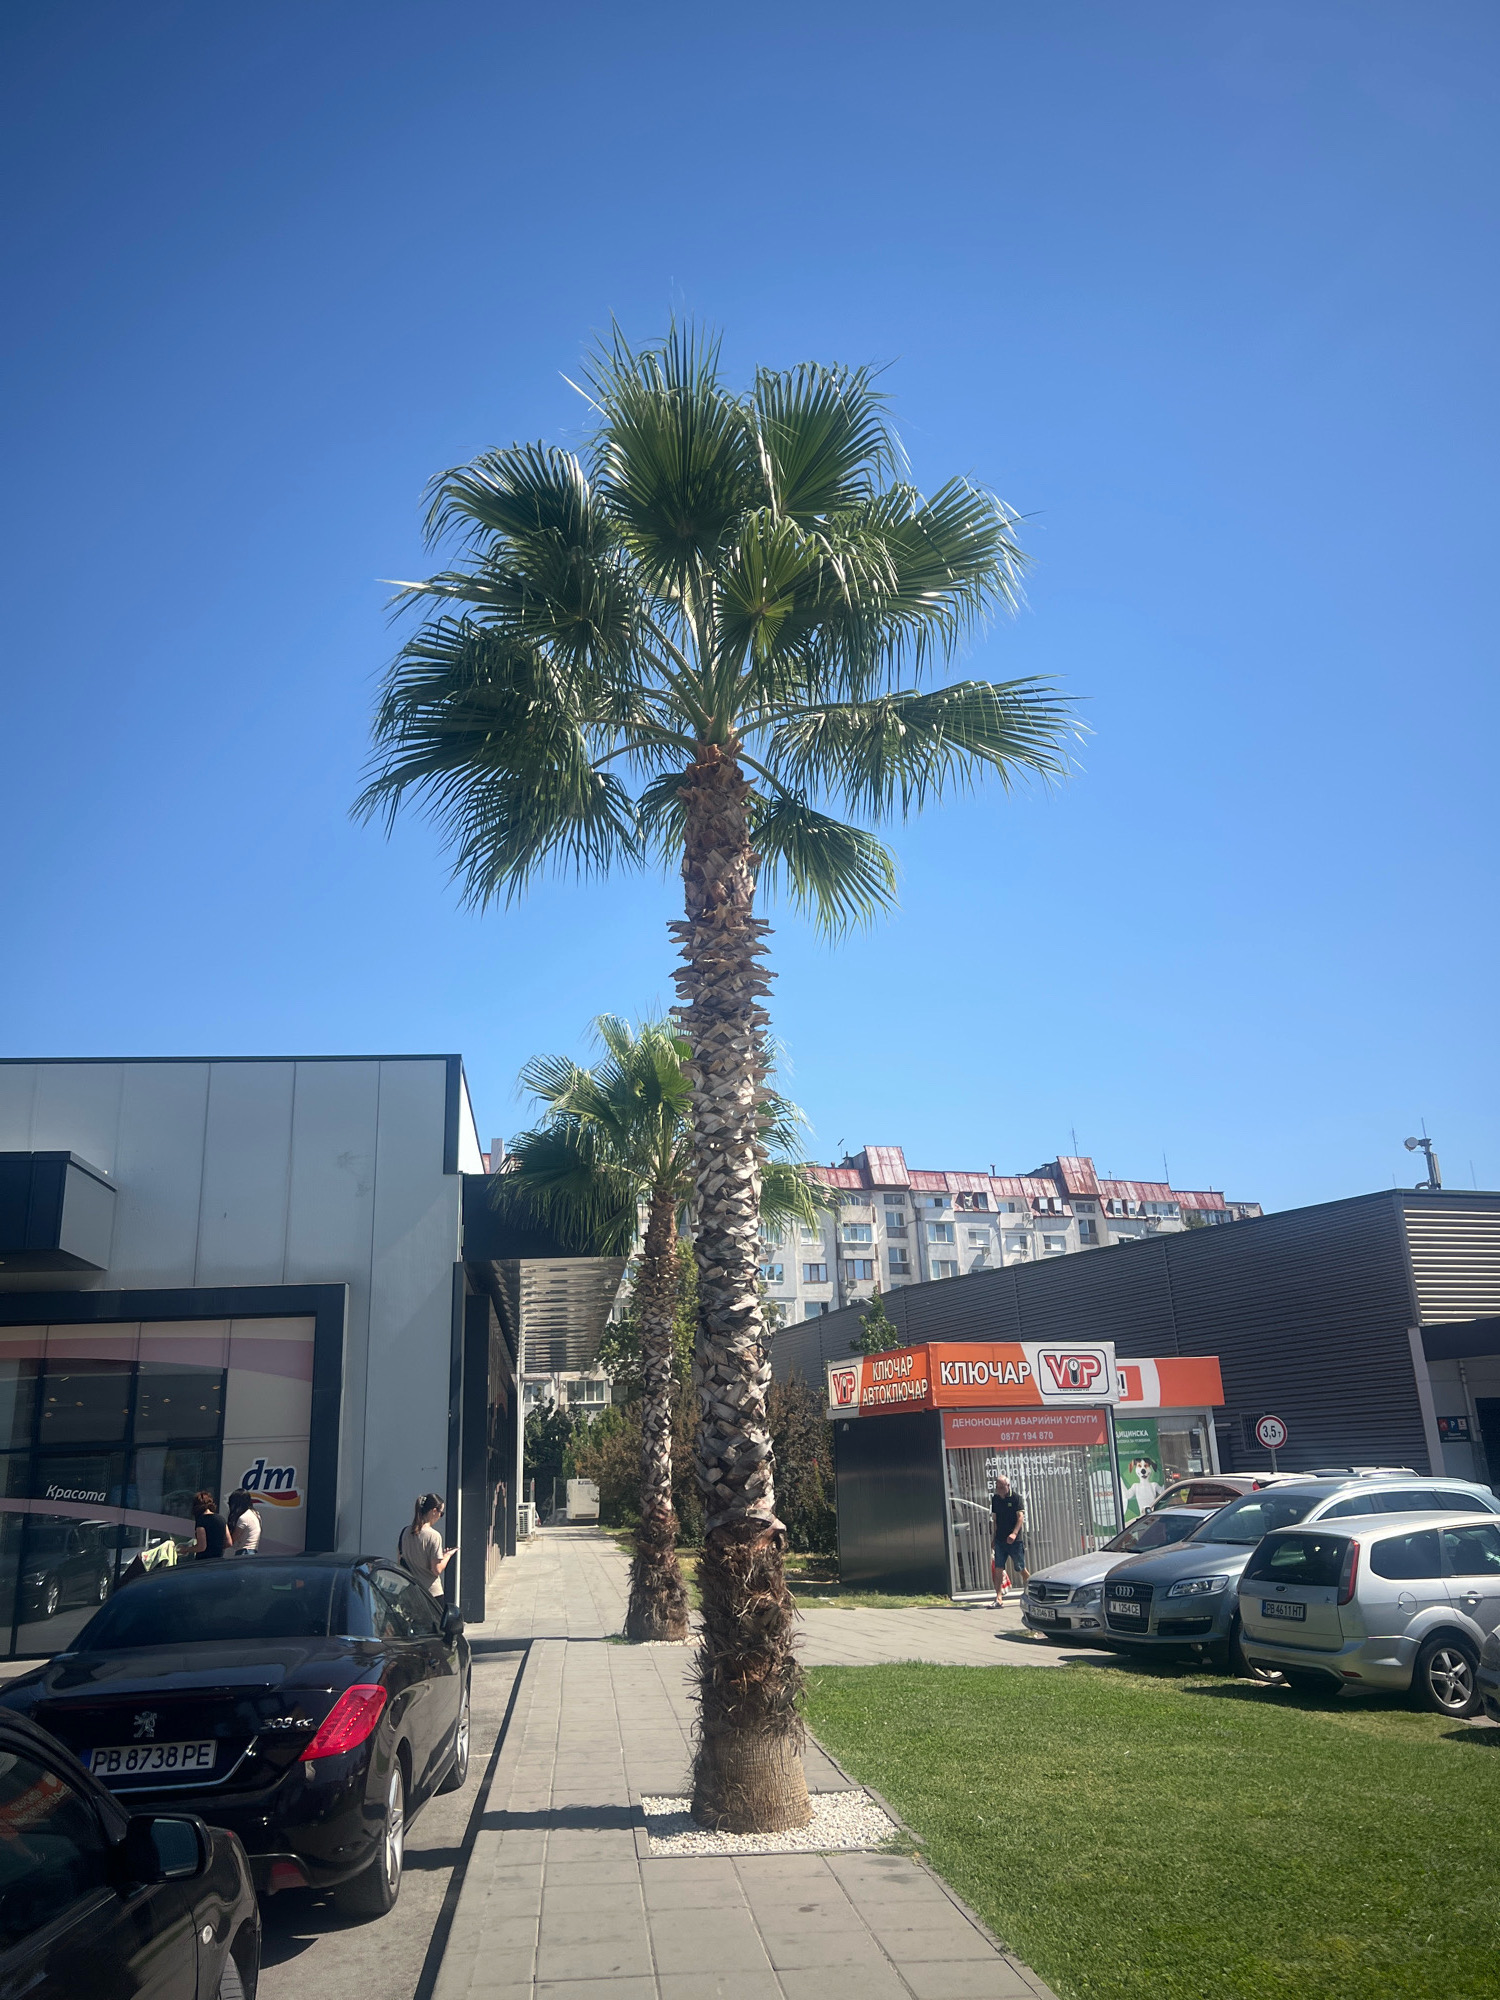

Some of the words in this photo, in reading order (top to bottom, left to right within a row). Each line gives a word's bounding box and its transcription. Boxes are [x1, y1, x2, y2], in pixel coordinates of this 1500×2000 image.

[872, 1355, 914, 1382] КЛЮЧАР
[940, 1361, 1032, 1385] КЛЮЧАР
[1043, 1355, 1102, 1388] VIP
[832, 1372, 856, 1404] VIP
[862, 1378, 928, 1406] АВТОКЛЮЧАР
[952, 1417, 1012, 1428] ДЕНОНОЩНИ
[1014, 1415, 1063, 1426] АВАРИЙНИ
[1064, 1415, 1098, 1425] УСЛУГИ
[1262, 1425, 1277, 1439] 3,5
[1000, 1432, 1019, 1441] 0877
[1022, 1431, 1037, 1440] 194
[1038, 1431, 1054, 1440] 870
[1115, 1429, 1149, 1439] ДИЦИНСКА
[242, 1459, 295, 1491] dm
[46, 1484, 107, 1502] Красота
[1276, 1604, 1292, 1615] 4611
[92, 1751, 121, 1774] PB
[126, 1745, 178, 1771] 8738
[182, 1743, 210, 1767] PE
